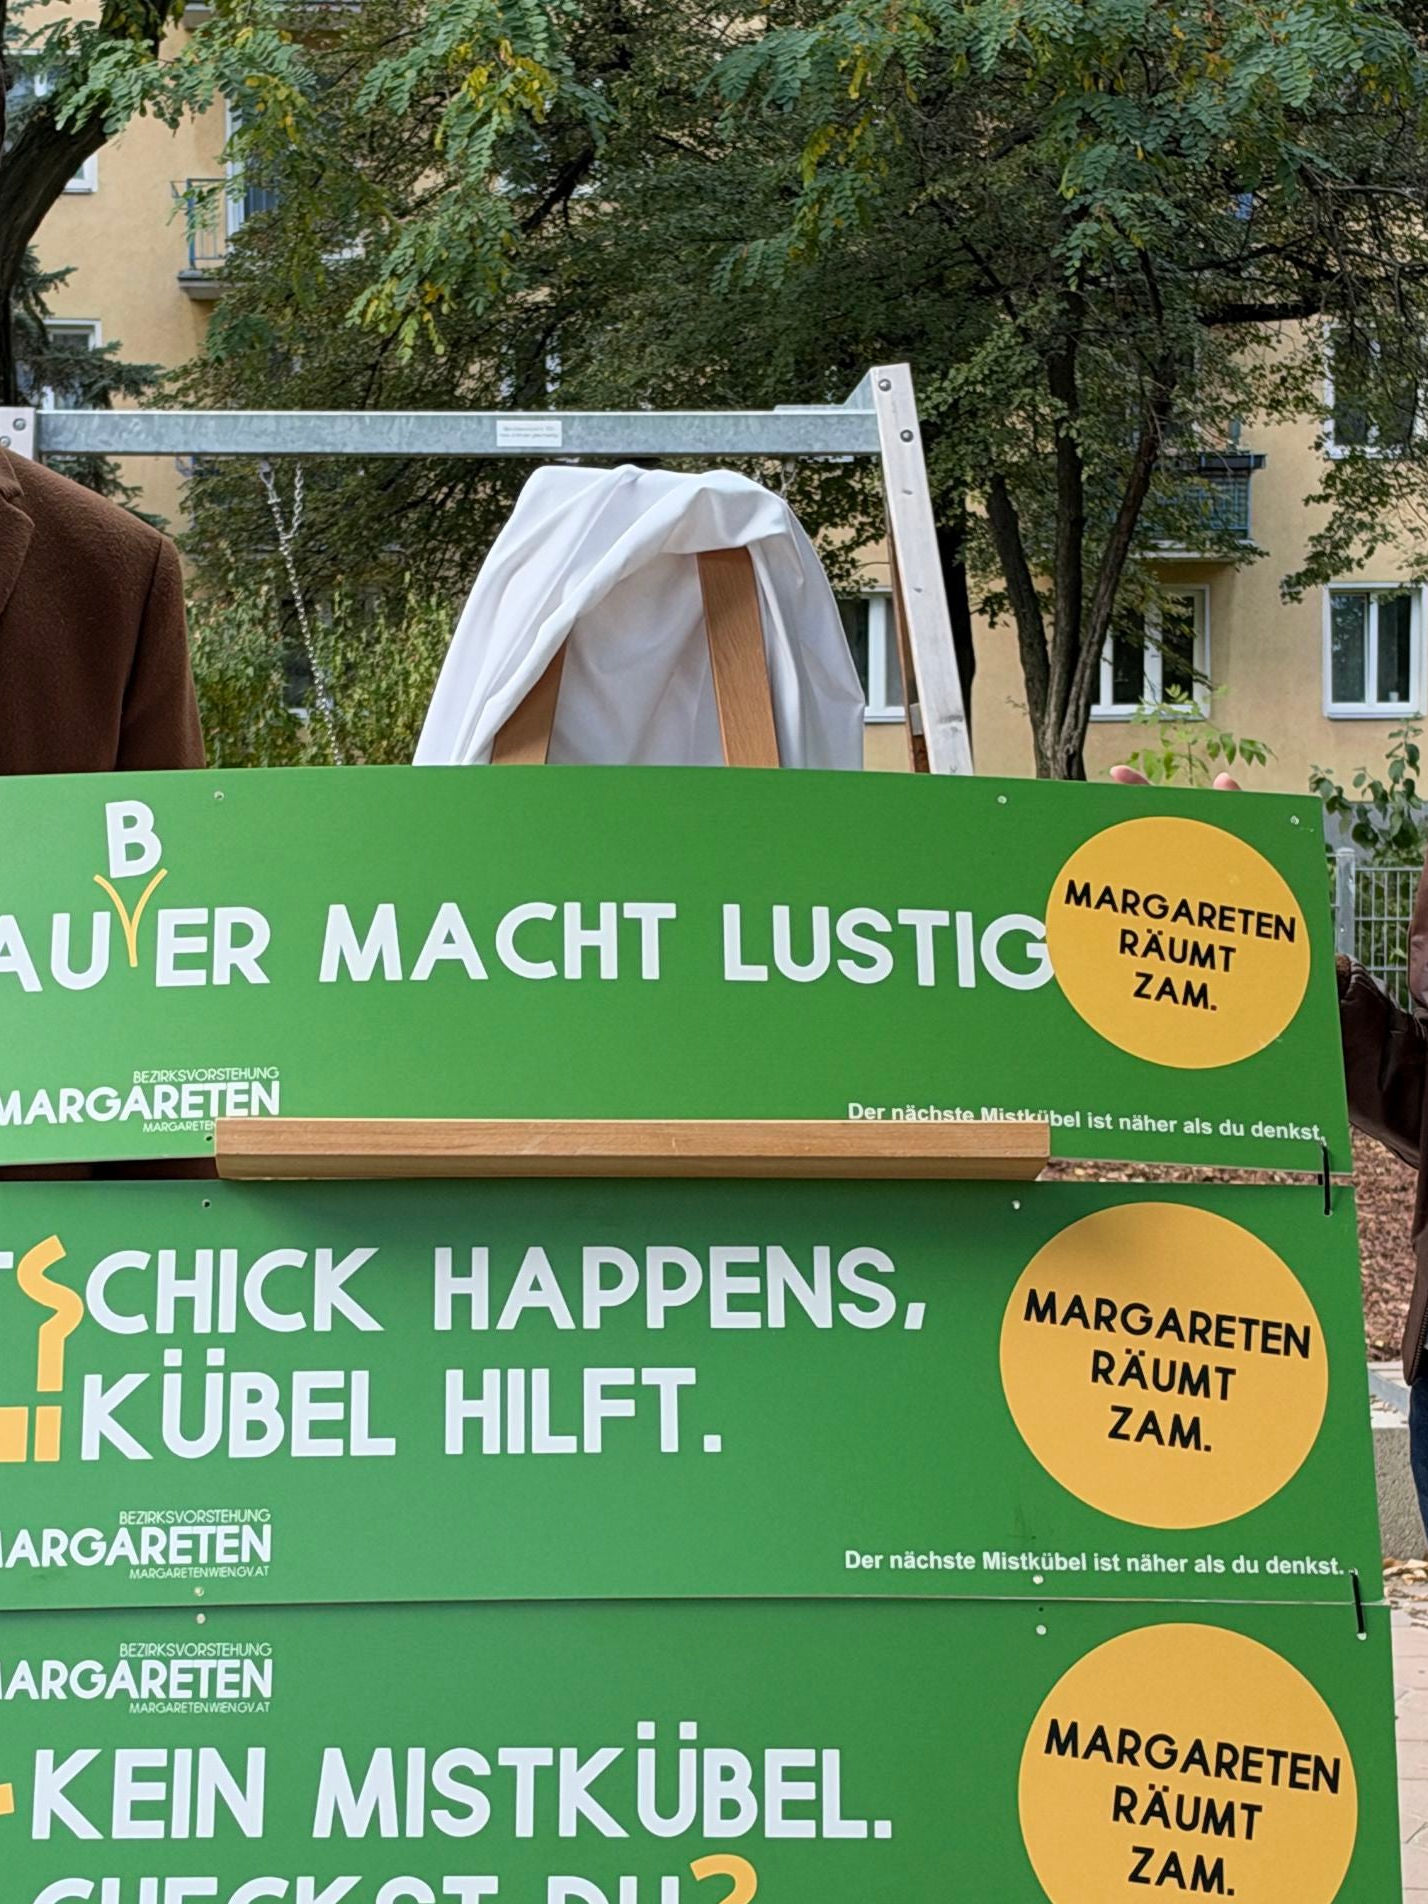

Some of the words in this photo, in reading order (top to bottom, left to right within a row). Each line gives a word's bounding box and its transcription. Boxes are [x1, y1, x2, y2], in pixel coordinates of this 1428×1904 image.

[1064, 879, 1296, 943] MARGARETEN
[318, 901, 677, 983] MACHT
[722, 903, 1056, 991] LUSTIG
[1119, 928, 1237, 973] RÄUMT
[1133, 971, 1218, 1011] ZAM.
[132, 1066, 280, 1084] BEZIRKSVORSTEHUNG
[847, 1102, 886, 1120] Der
[891, 1104, 975, 1121] nächste
[980, 1106, 1080, 1128] Mistkübel
[1087, 1112, 1113, 1130] ist
[1118, 1114, 1177, 1133] näher
[1183, 1117, 1213, 1135] als
[1219, 1119, 1245, 1137] du
[434, 1245, 926, 1331] HAPPENS,
[1023, 1288, 1311, 1359] MARGARETEN
[1090, 1348, 1236, 1401] RÄUMT
[80, 1347, 397, 1461] KÜBEL
[444, 1367, 722, 1455] HILFT.
[1107, 1404, 1212, 1452] ZAM.
[119, 1508, 271, 1525] BEZIRKSVORSTEHUNG
[844, 1549, 883, 1570] Der
[889, 1550, 976, 1570] nächste
[982, 1551, 1087, 1571] Mistkübel
[1093, 1552, 1121, 1572] ist
[1126, 1553, 1188, 1573] näher
[1194, 1554, 1225, 1574] als
[1231, 1555, 1259, 1574] du
[1265, 1555, 1344, 1575] denkst.
[119, 1642, 272, 1658] BEZIRKSVORSTEHUNG
[30, 1747, 266, 1840] KEIN
[312, 1720, 892, 1839] MISTKÜBEL.
[1043, 1718, 1341, 1794] MARGARETEN
[1112, 1783, 1263, 1841] RÄUMT
[1128, 1845, 1235, 1896] ZAM.
